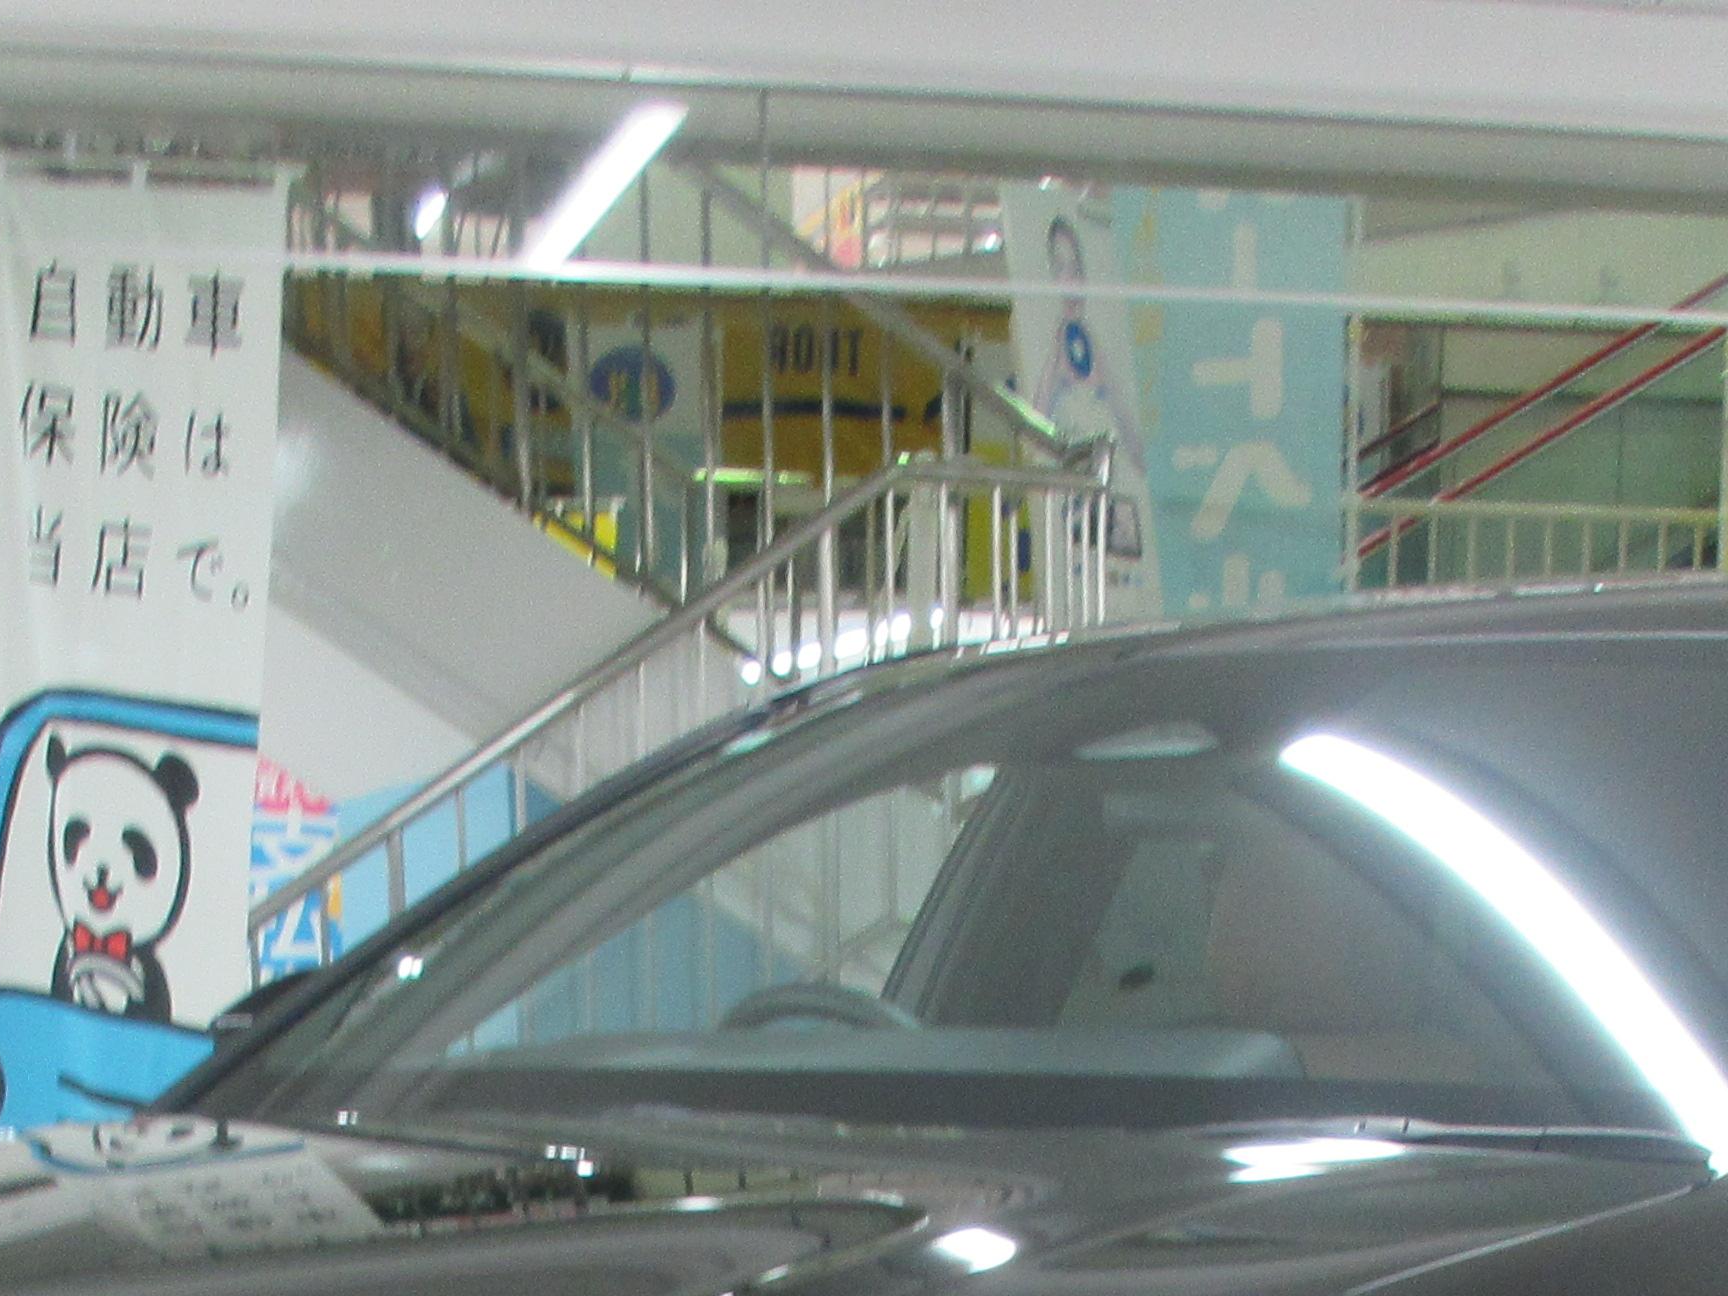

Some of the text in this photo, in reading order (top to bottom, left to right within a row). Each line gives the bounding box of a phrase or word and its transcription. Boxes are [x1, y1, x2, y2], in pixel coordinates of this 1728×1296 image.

[30, 258, 246, 361] 自動車
[20, 379, 231, 481] 保険は
[27, 503, 251, 612] 当店で。
